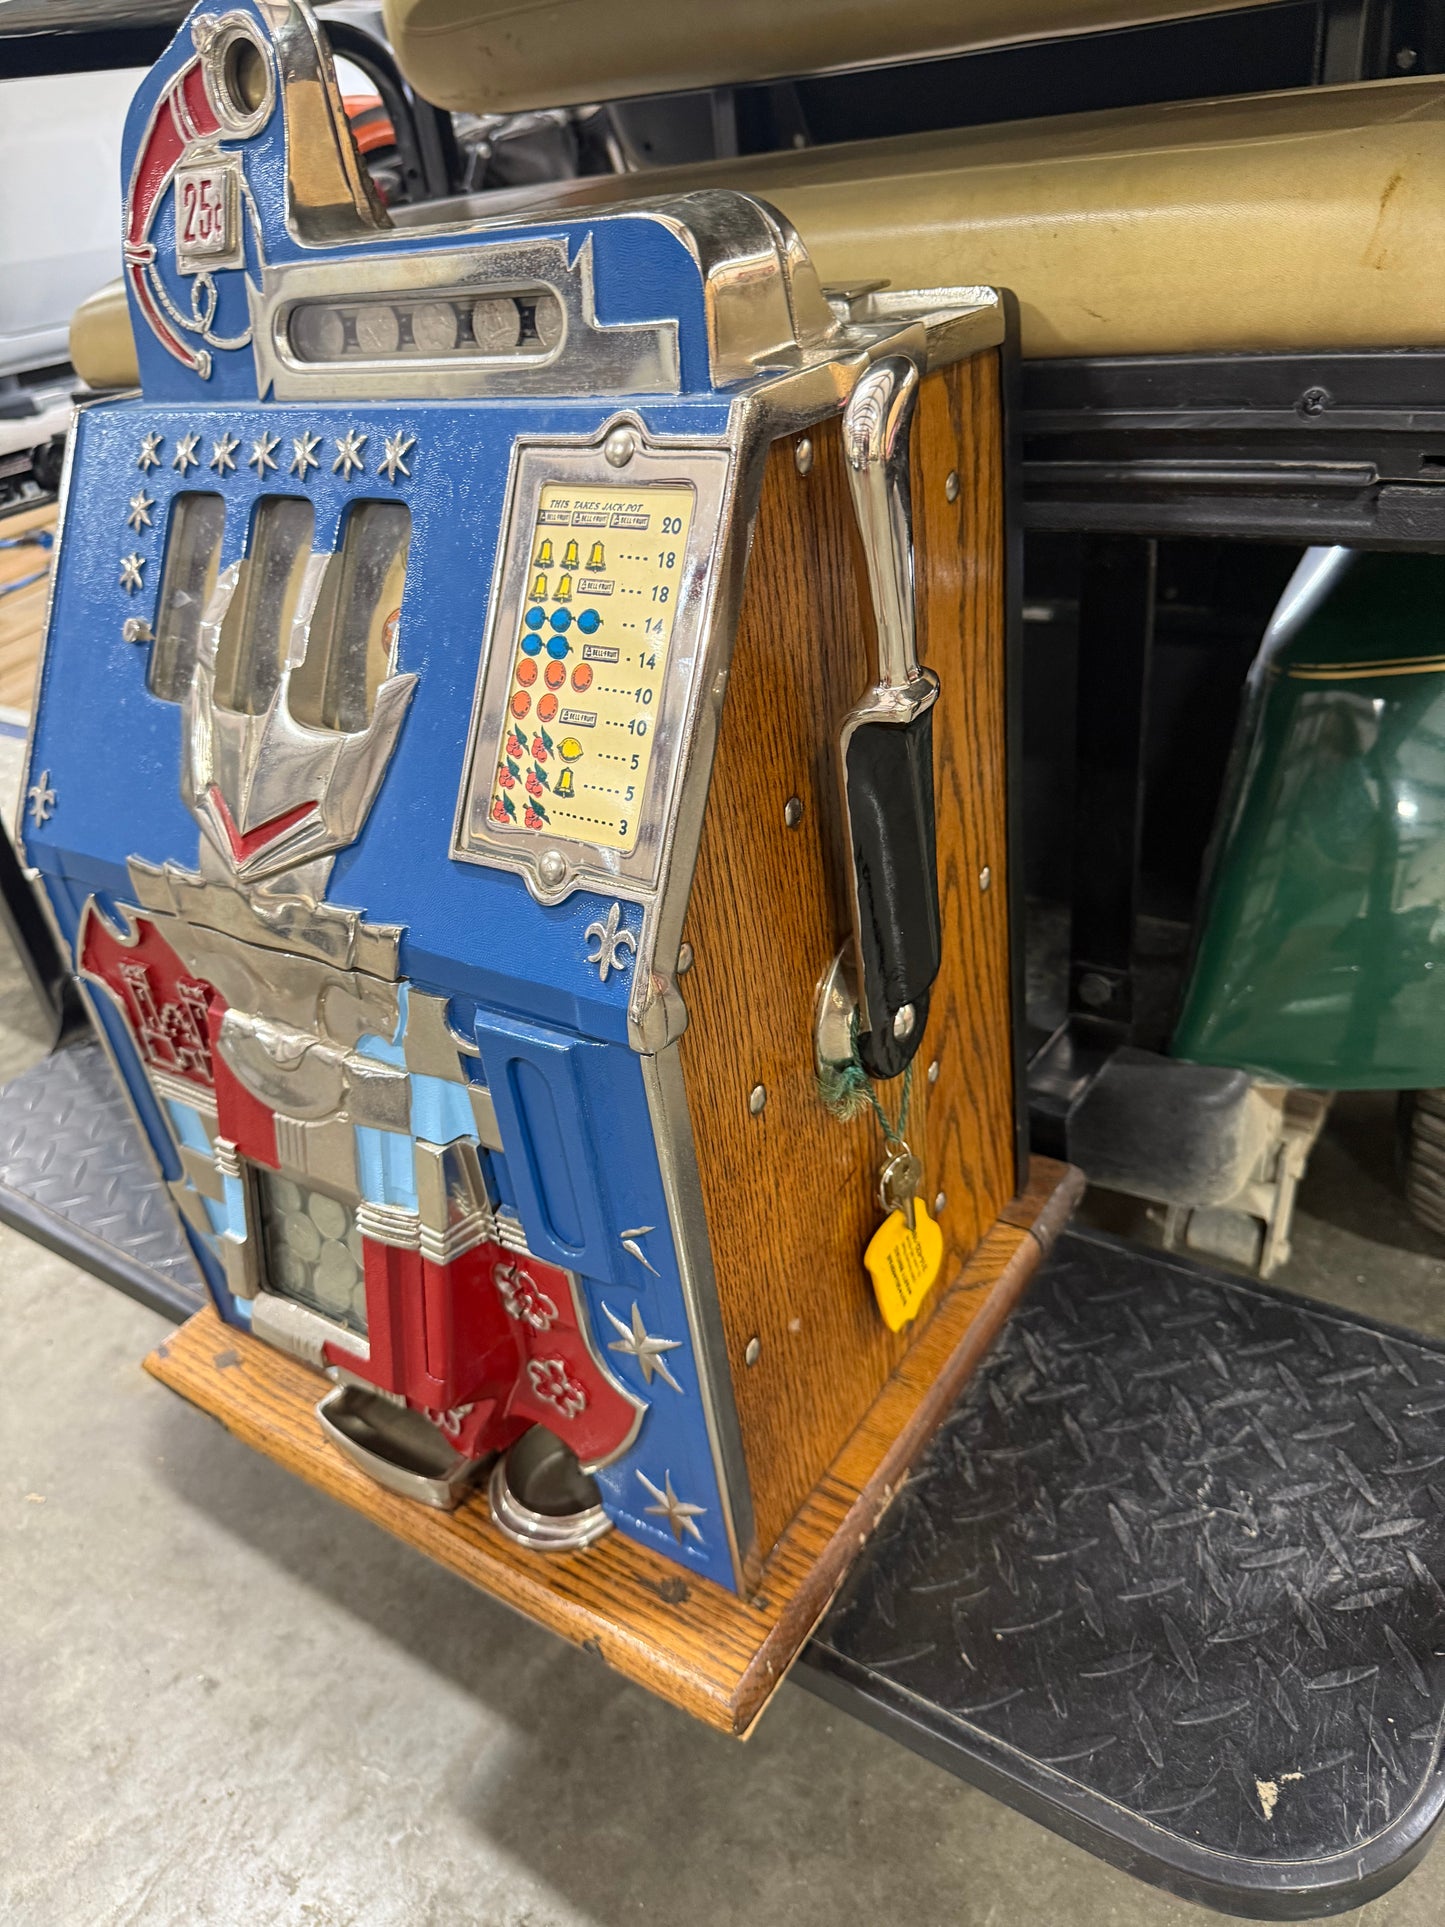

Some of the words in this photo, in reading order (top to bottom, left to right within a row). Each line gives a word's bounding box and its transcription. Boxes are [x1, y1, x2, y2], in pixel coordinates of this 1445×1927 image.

[549, 499, 570, 509] THIS
[573, 500, 601, 510] TAKES
[601, 502, 625, 512] JACK
[625, 503, 644, 513] POT
[661, 517, 682, 535] 20
[657, 551, 676, 569] 18
[651, 586, 670, 603] 18
[644, 617, 664, 634] 14
[638, 652, 656, 670] 14
[635, 687, 653, 705] 10
[629, 719, 647, 737] 10
[630, 754, 640, 770] 5
[625, 785, 635, 802] 5
[619, 819, 628, 835] 3
